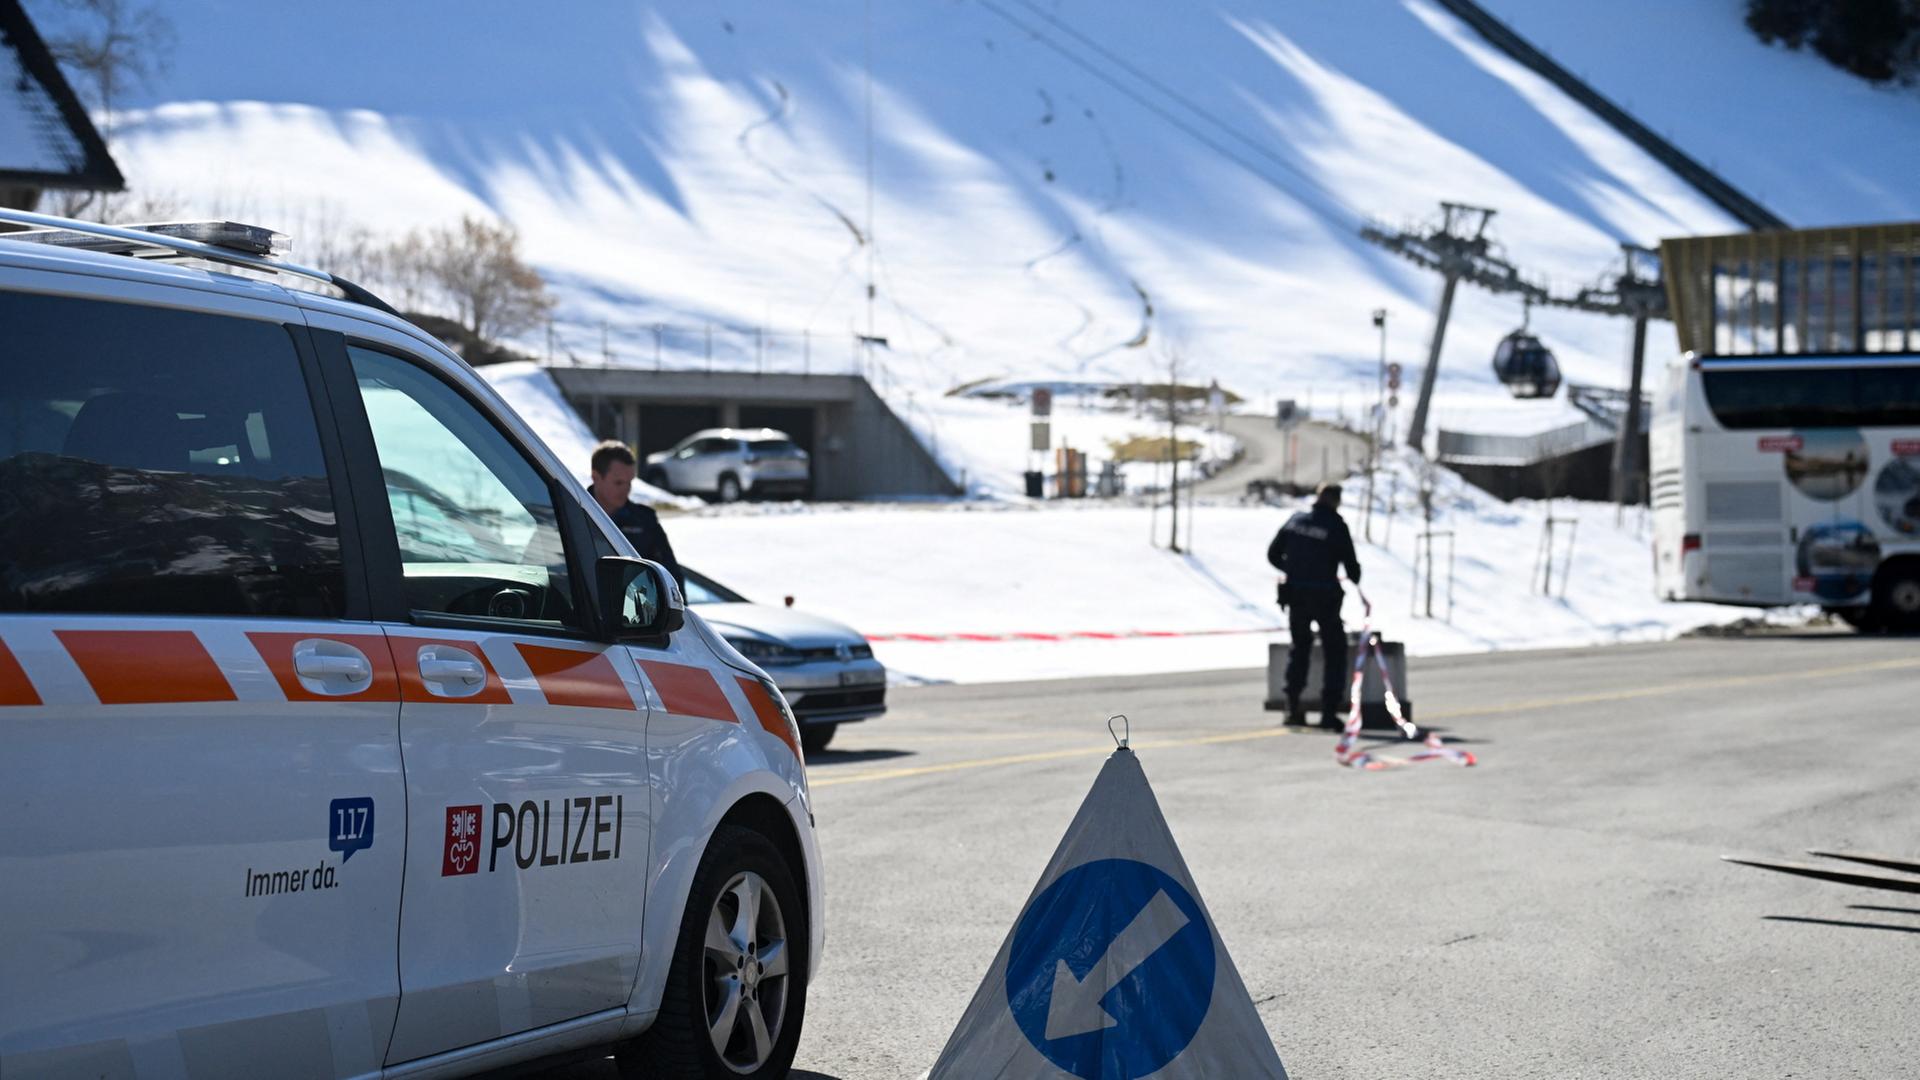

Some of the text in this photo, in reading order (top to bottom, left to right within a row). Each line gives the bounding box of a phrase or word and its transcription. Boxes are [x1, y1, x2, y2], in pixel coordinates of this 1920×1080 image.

[336, 806, 369, 841] 117
[488, 794, 623, 873] POLIZEI
[245, 859, 340, 898] Immer da.
